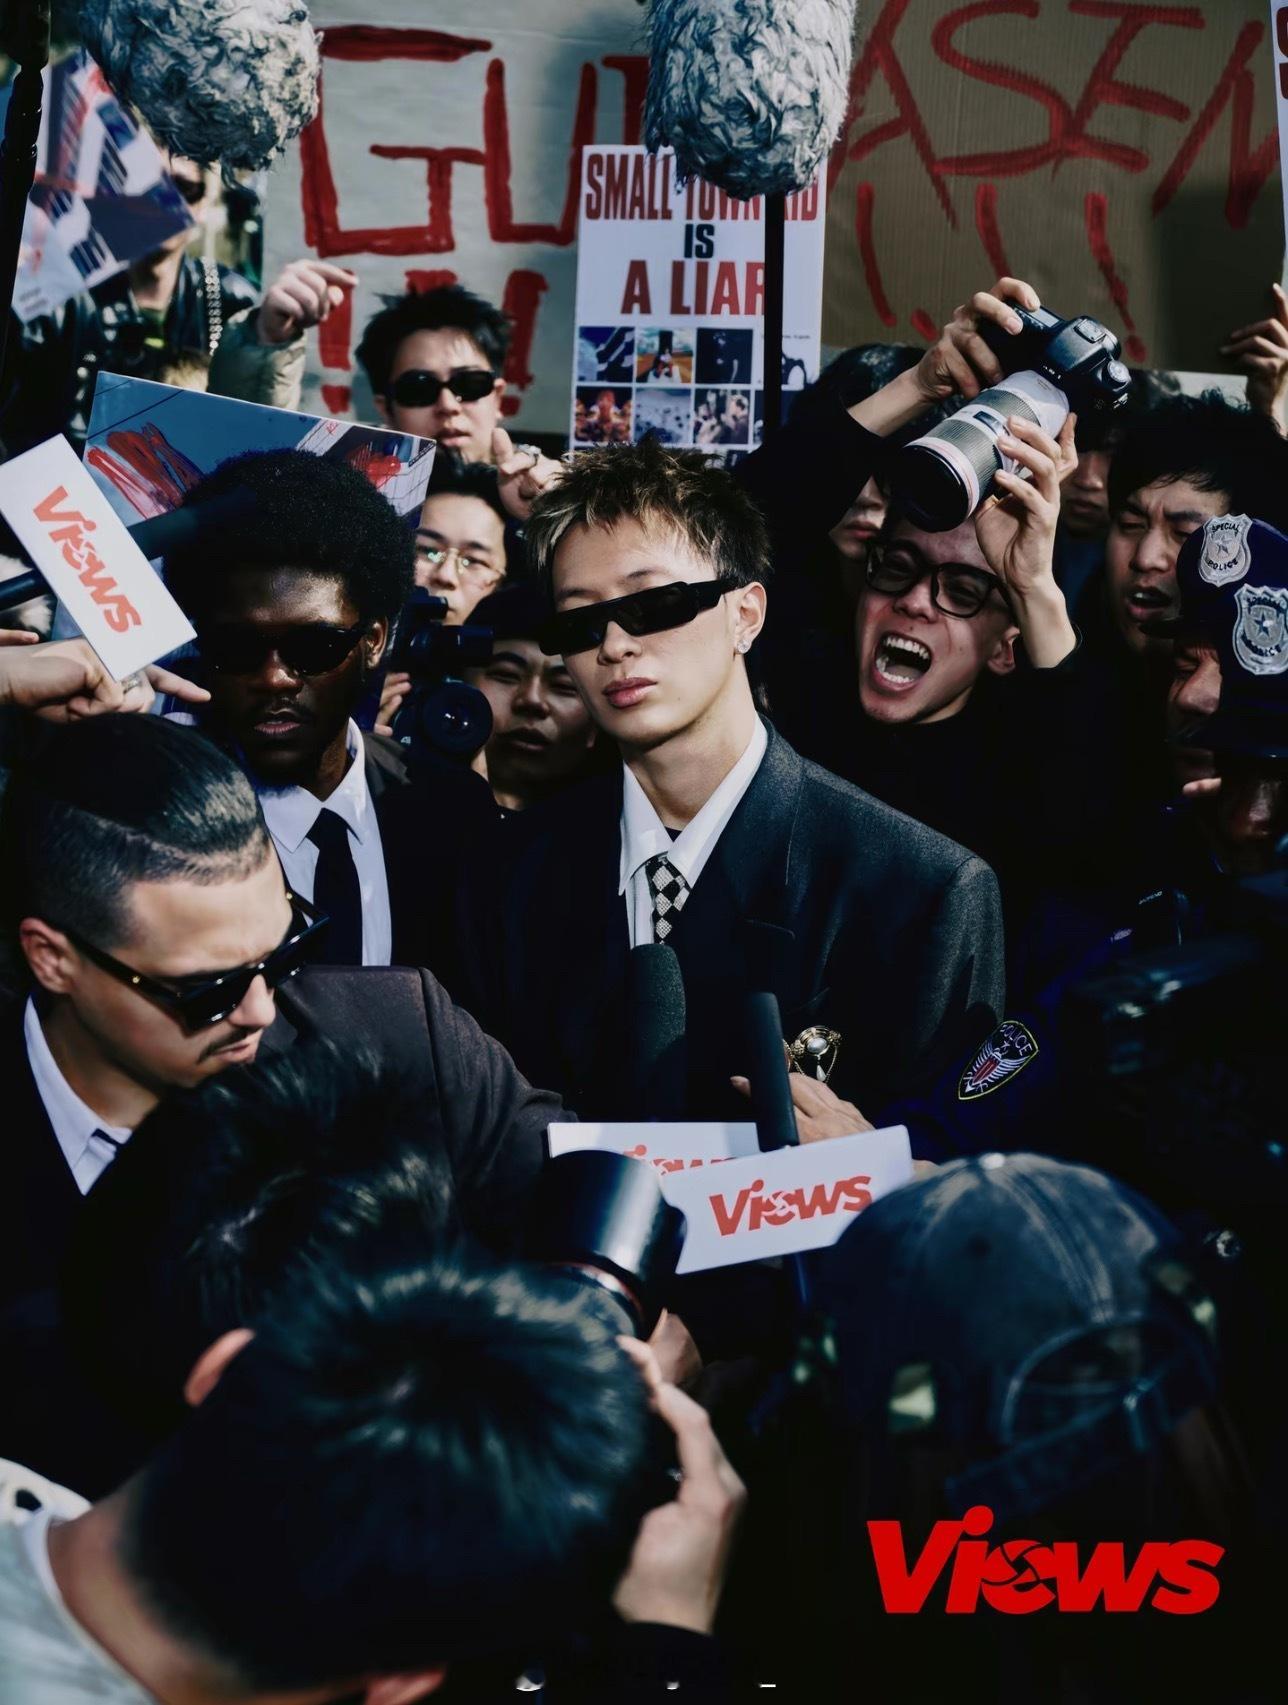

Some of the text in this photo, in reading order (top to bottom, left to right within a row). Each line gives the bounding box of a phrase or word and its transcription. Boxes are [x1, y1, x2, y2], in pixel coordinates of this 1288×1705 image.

[585, 154, 673, 220] SMALL
[683, 223, 715, 259] IS
[620, 259, 765, 316] A LIAR
[1211, 522, 1240, 534] SPECIAL
[33, 485, 142, 633] Views
[1207, 558, 1238, 571] POLICE
[709, 1175, 873, 1237] Views
